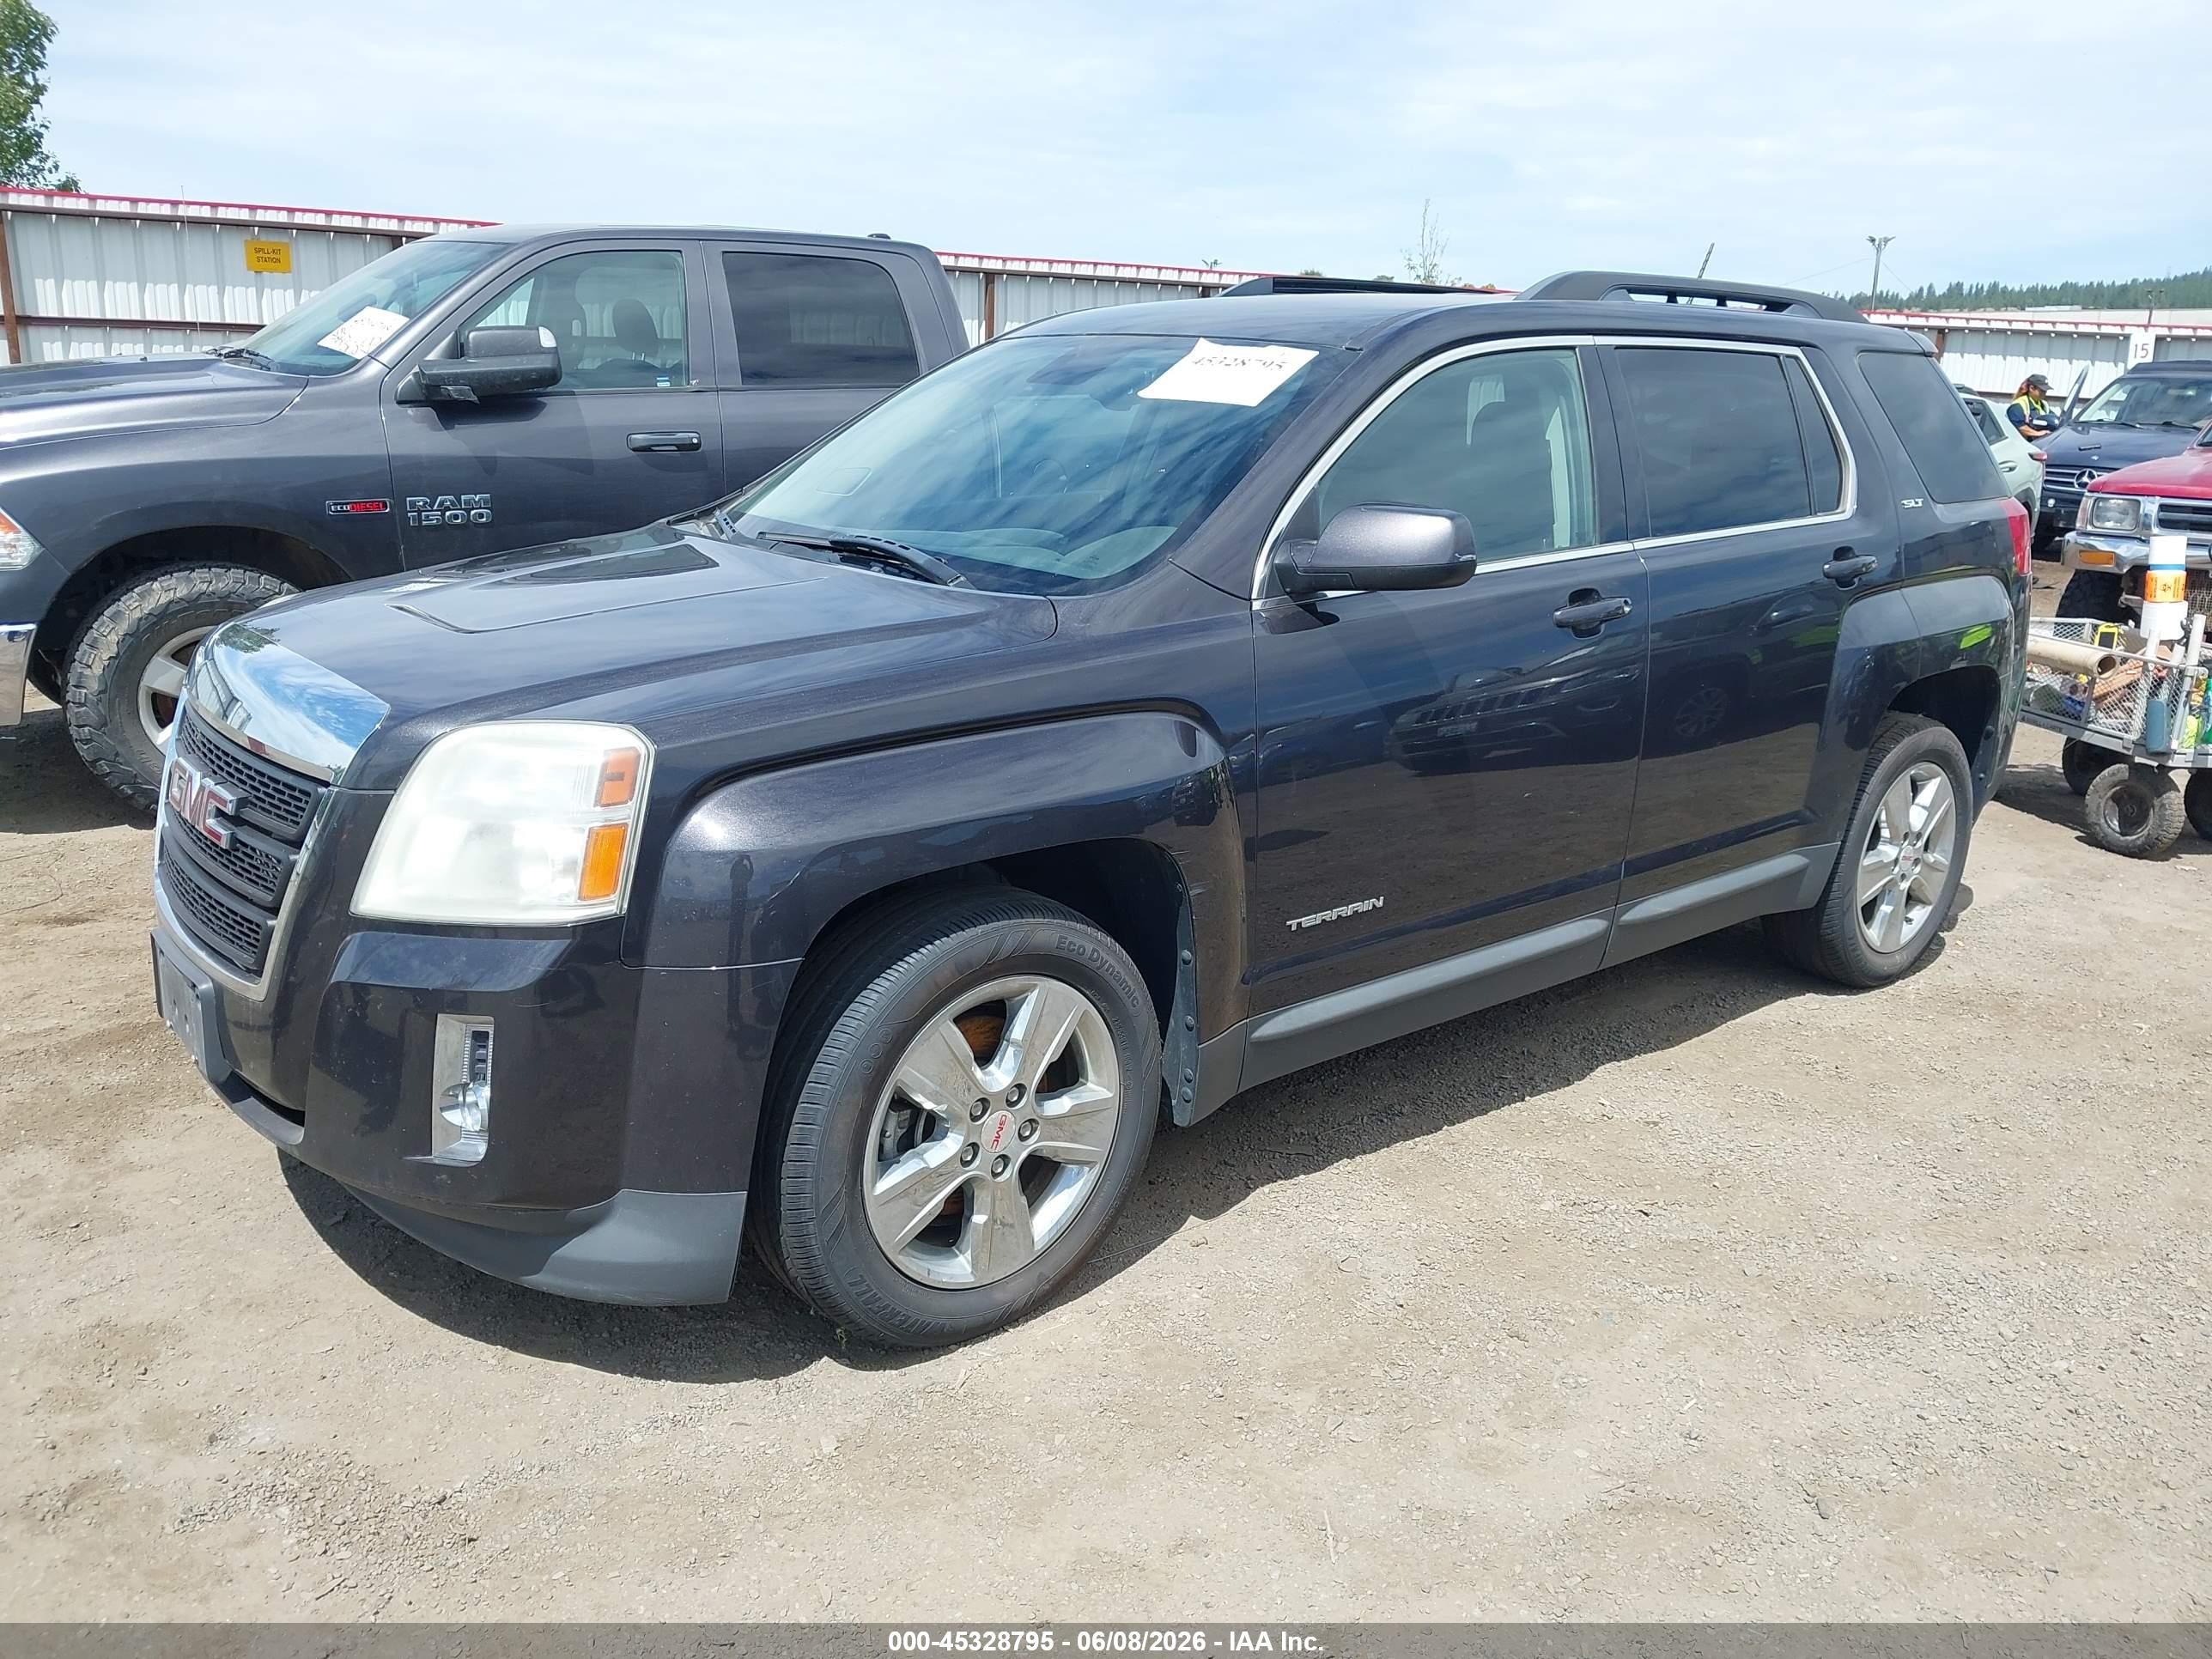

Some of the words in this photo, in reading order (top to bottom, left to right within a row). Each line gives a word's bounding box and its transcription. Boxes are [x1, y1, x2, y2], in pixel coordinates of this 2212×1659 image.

[254, 246, 282, 256] SPILL-KIT
[2133, 343, 2150, 359] 15
[331, 501, 386, 513] ECODIESEL
[406, 494, 492, 511] RAM
[1900, 498, 1924, 508] SLT
[407, 509, 493, 526] 1500
[168, 757, 241, 850] GMC
[1285, 896, 1384, 932] TERRAIN
[1056, 934, 1086, 957] Eco
[1088, 947, 1139, 1008] Dynamic
[990, 1114, 1007, 1150] GMC
